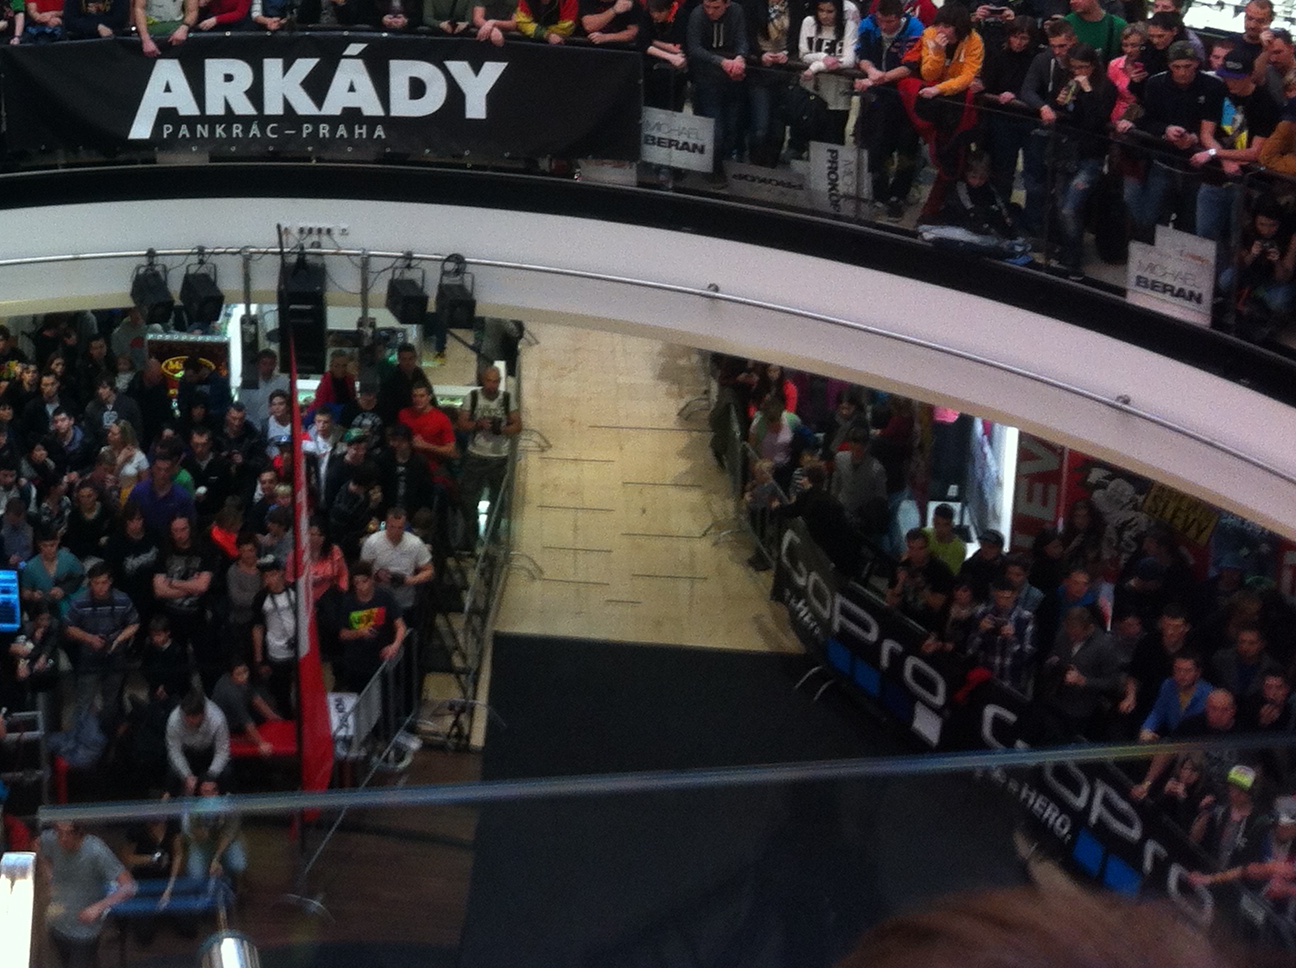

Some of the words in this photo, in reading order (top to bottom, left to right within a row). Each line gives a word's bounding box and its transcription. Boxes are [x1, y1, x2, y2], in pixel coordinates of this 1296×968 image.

[128, 43, 508, 139] ARKÁDY
[644, 133, 706, 154] BERAN
[827, 148, 841, 213] PROKOP
[1135, 274, 1204, 305] BERAN
